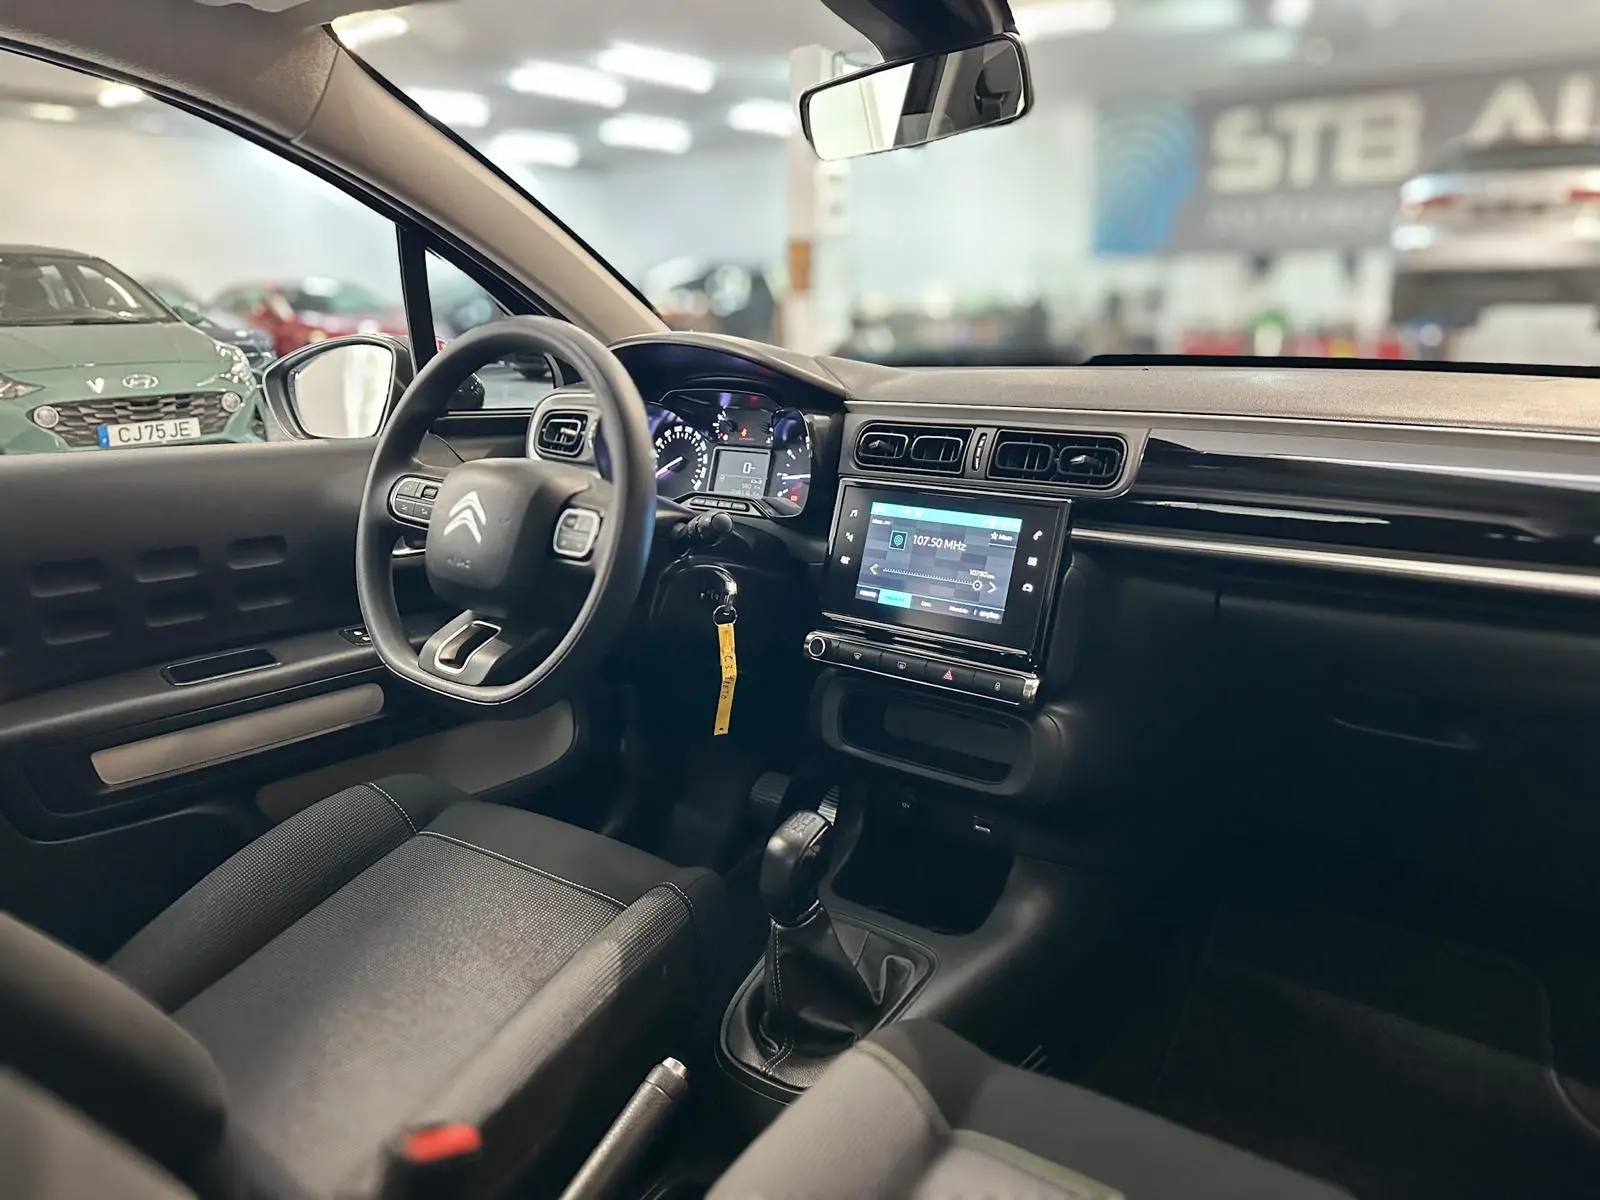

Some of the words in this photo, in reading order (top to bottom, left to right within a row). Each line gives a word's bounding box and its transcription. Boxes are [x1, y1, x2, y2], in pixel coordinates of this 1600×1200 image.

[1211, 91, 1422, 191] STB
[913, 534, 943, 549] 107.50
[943, 538, 967, 552] MHz
